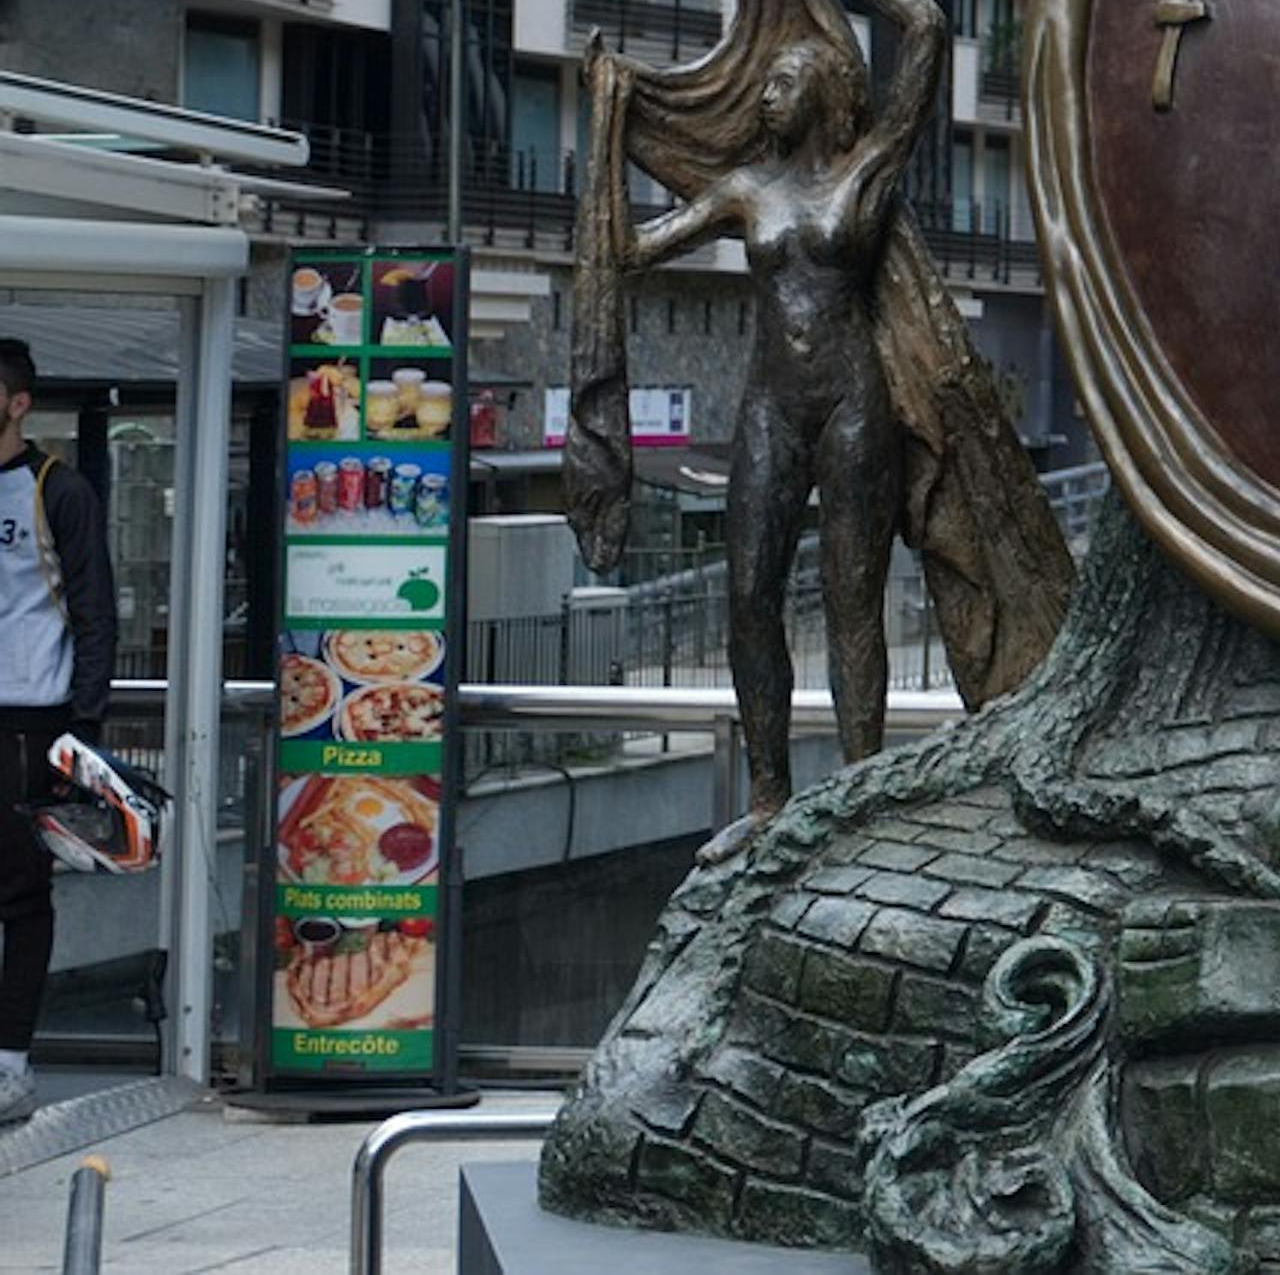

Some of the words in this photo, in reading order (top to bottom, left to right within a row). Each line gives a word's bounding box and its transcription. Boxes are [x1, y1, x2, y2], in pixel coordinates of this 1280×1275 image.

[323, 745, 383, 766] Pizza
[285, 887, 321, 909] Plats
[325, 890, 421, 909] combinats
[294, 1032, 400, 1055] Entrecôte
